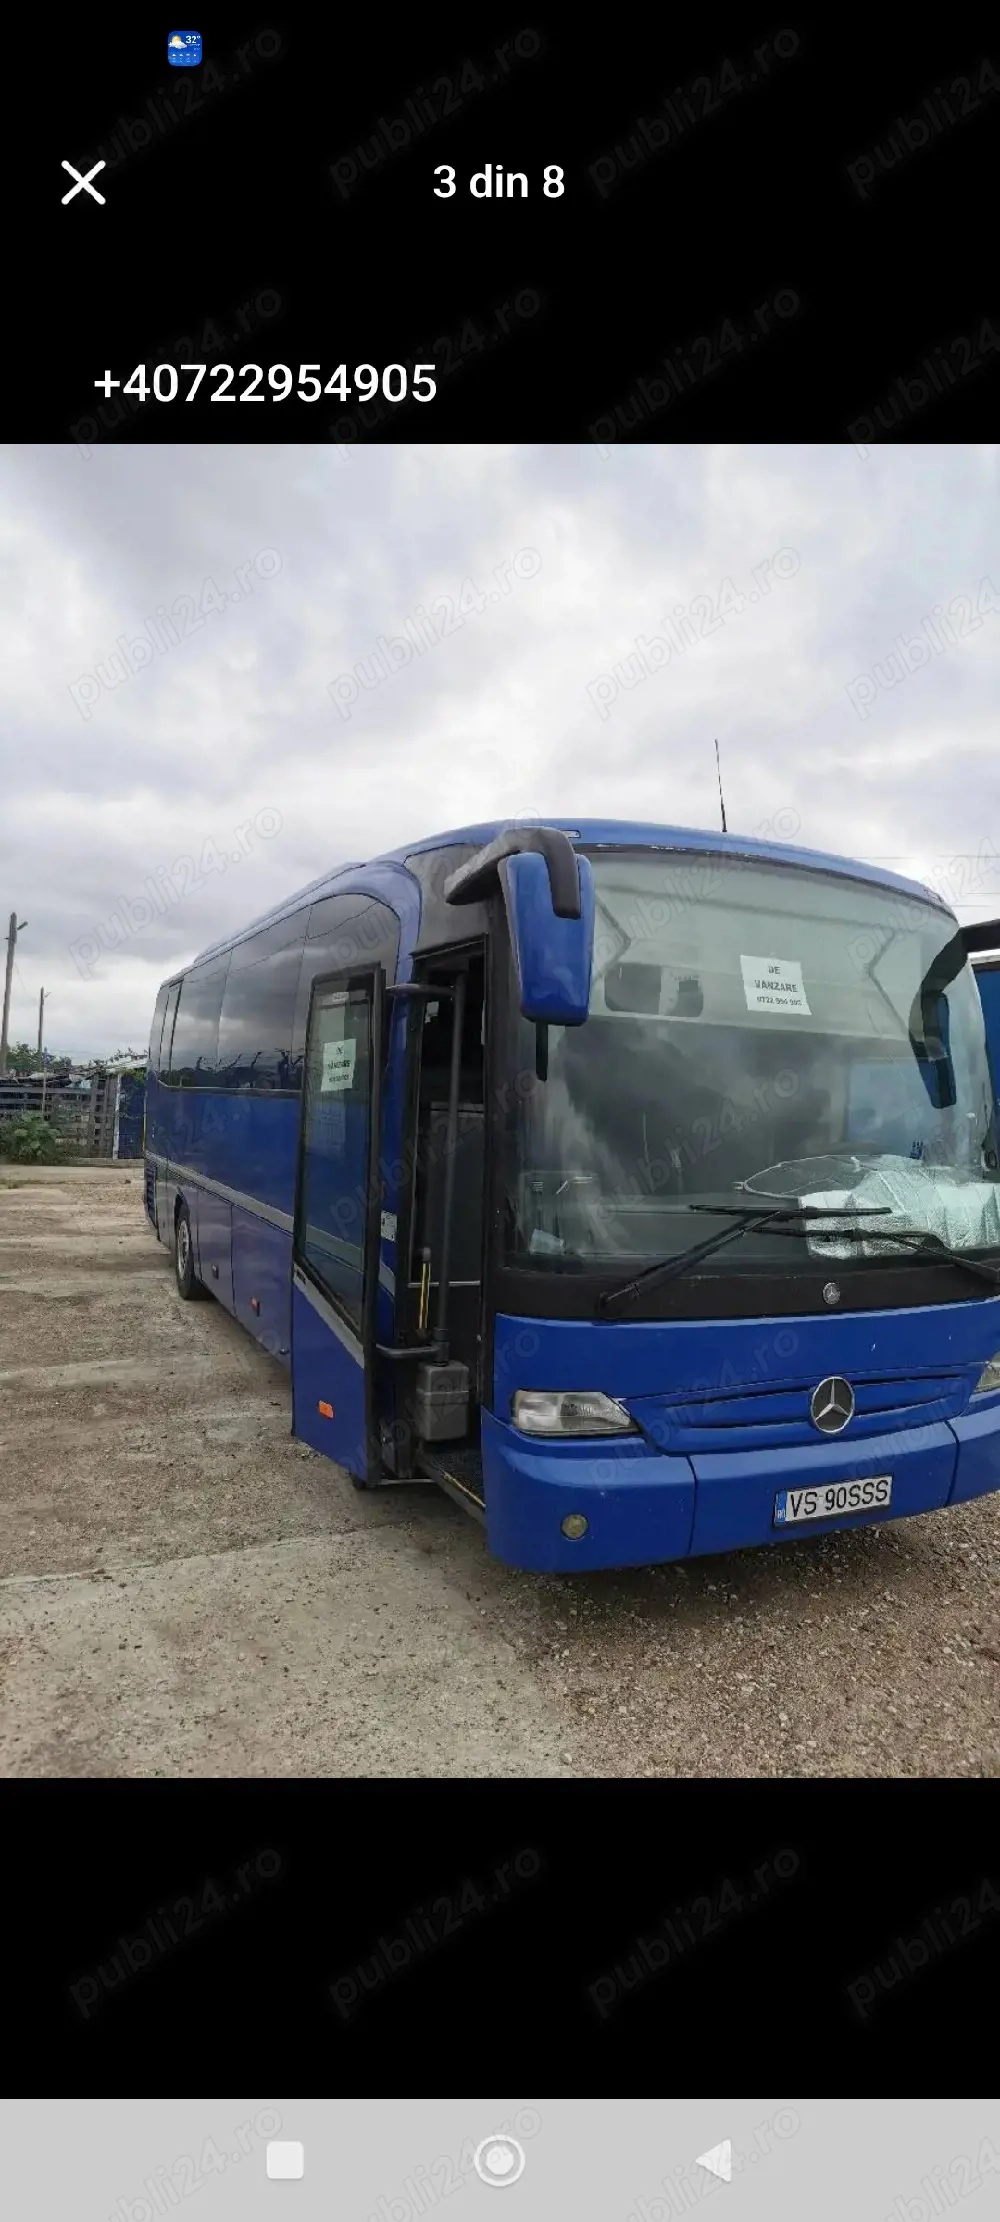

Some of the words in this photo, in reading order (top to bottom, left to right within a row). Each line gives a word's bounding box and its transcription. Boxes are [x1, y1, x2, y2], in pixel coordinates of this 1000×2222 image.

[768, 965, 781, 975] DE
[754, 979, 799, 993] VANZARE
[790, 1491, 818, 1517] VS
[825, 1479, 889, 1511] 90SSS
